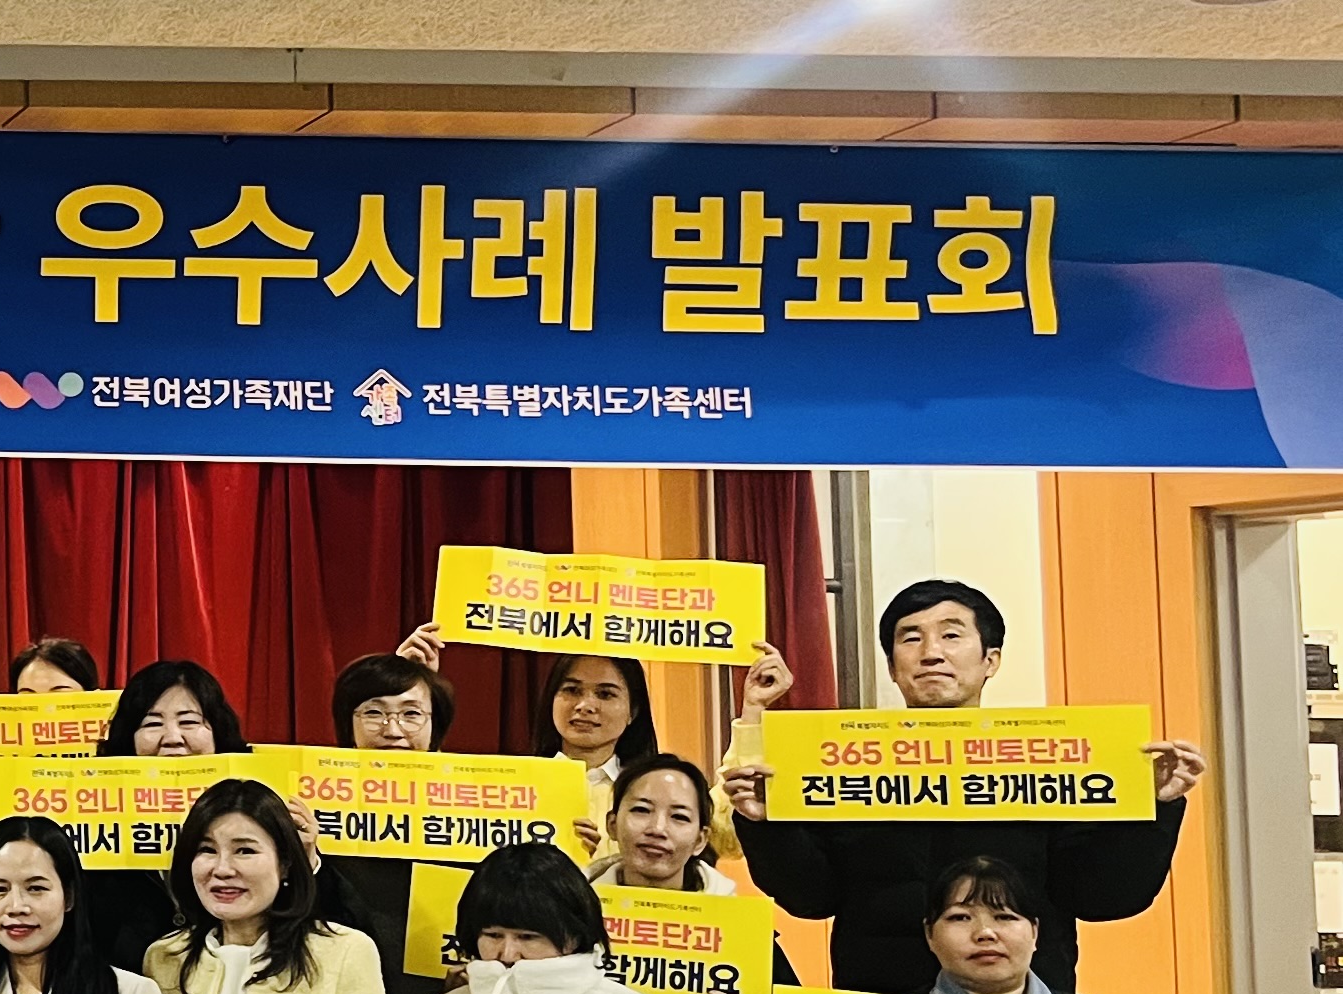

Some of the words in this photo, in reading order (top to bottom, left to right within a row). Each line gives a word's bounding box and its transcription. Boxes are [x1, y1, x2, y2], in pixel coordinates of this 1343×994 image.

[41, 185, 596, 330] 우수사례
[652, 191, 1057, 334] 발표회
[92, 377, 334, 411] 전북여성가족재단
[423, 383, 751, 418] 전북특별자치도가족센터
[487, 574, 539, 600] 365
[548, 582, 598, 604] 언니
[610, 582, 714, 610] 멘토단과
[465, 602, 592, 639] 전북에서
[604, 614, 733, 649] 함께해요
[32, 722, 110, 745] 멘토단
[821, 741, 882, 766] 365
[893, 741, 951, 765] 언니
[964, 739, 1090, 764] 멘토단과
[13, 788, 67, 813] 365
[77, 789, 123, 813] 언니
[135, 788, 211, 813] 멘토단
[299, 776, 352, 801] 365
[363, 780, 415, 804] 언니
[427, 783, 535, 812] 멘토단과
[802, 775, 948, 805] 전북에서
[961, 774, 1116, 804] 함께해요
[314, 810, 410, 843] 북에서
[423, 815, 557, 850] 함께해요
[604, 918, 721, 952] 멘토단과
